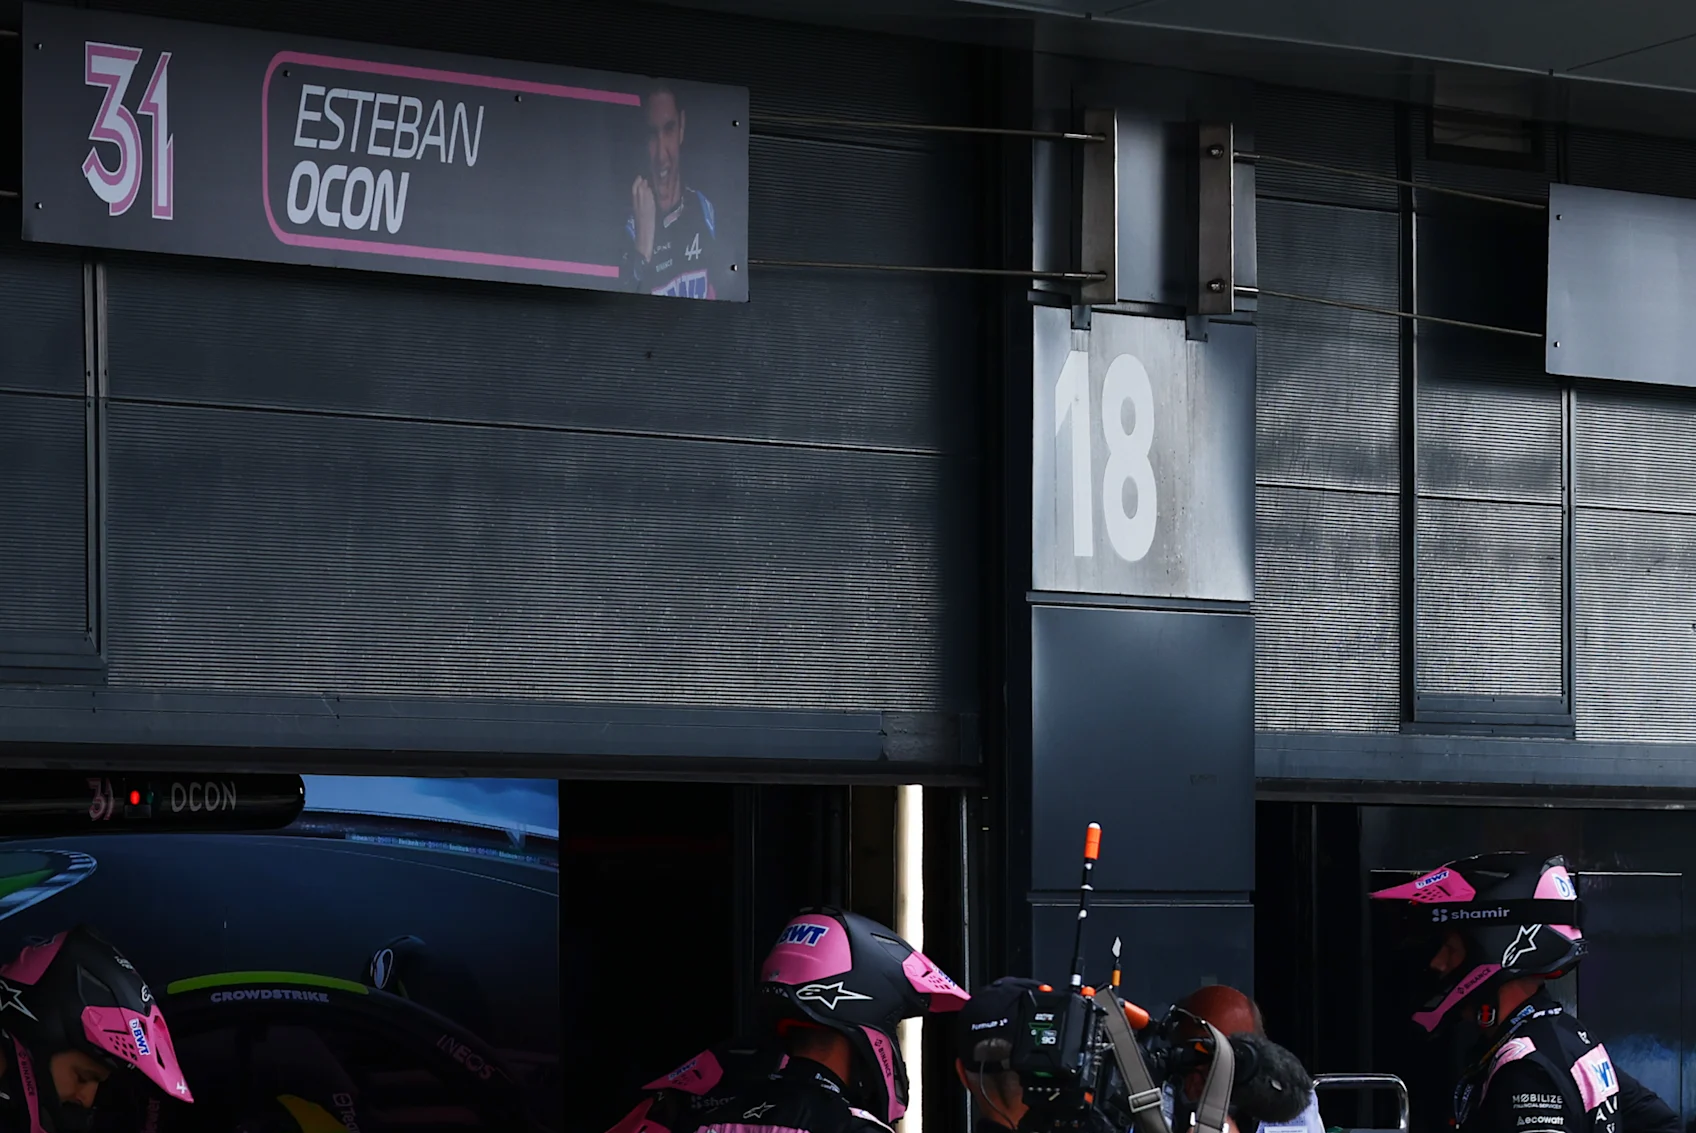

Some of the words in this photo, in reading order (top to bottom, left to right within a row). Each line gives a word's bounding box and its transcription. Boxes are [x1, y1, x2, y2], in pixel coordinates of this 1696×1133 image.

[82, 41, 173, 220] 31
[293, 84, 485, 167] ESTEBAN
[286, 161, 409, 234] OCON
[1055, 350, 1158, 562] 18
[169, 780, 237, 813] OCON
[1424, 871, 1449, 886] BWT
[1451, 907, 1510, 920] shamir
[777, 922, 830, 947] BWT
[210, 988, 330, 1003] CROWDSTRIKE
[133, 1028, 150, 1055] BWT
[436, 1034, 496, 1082] INEOS
[878, 1046, 894, 1079] BINANCE
[1524, 1116, 1564, 1125] ecowatt
